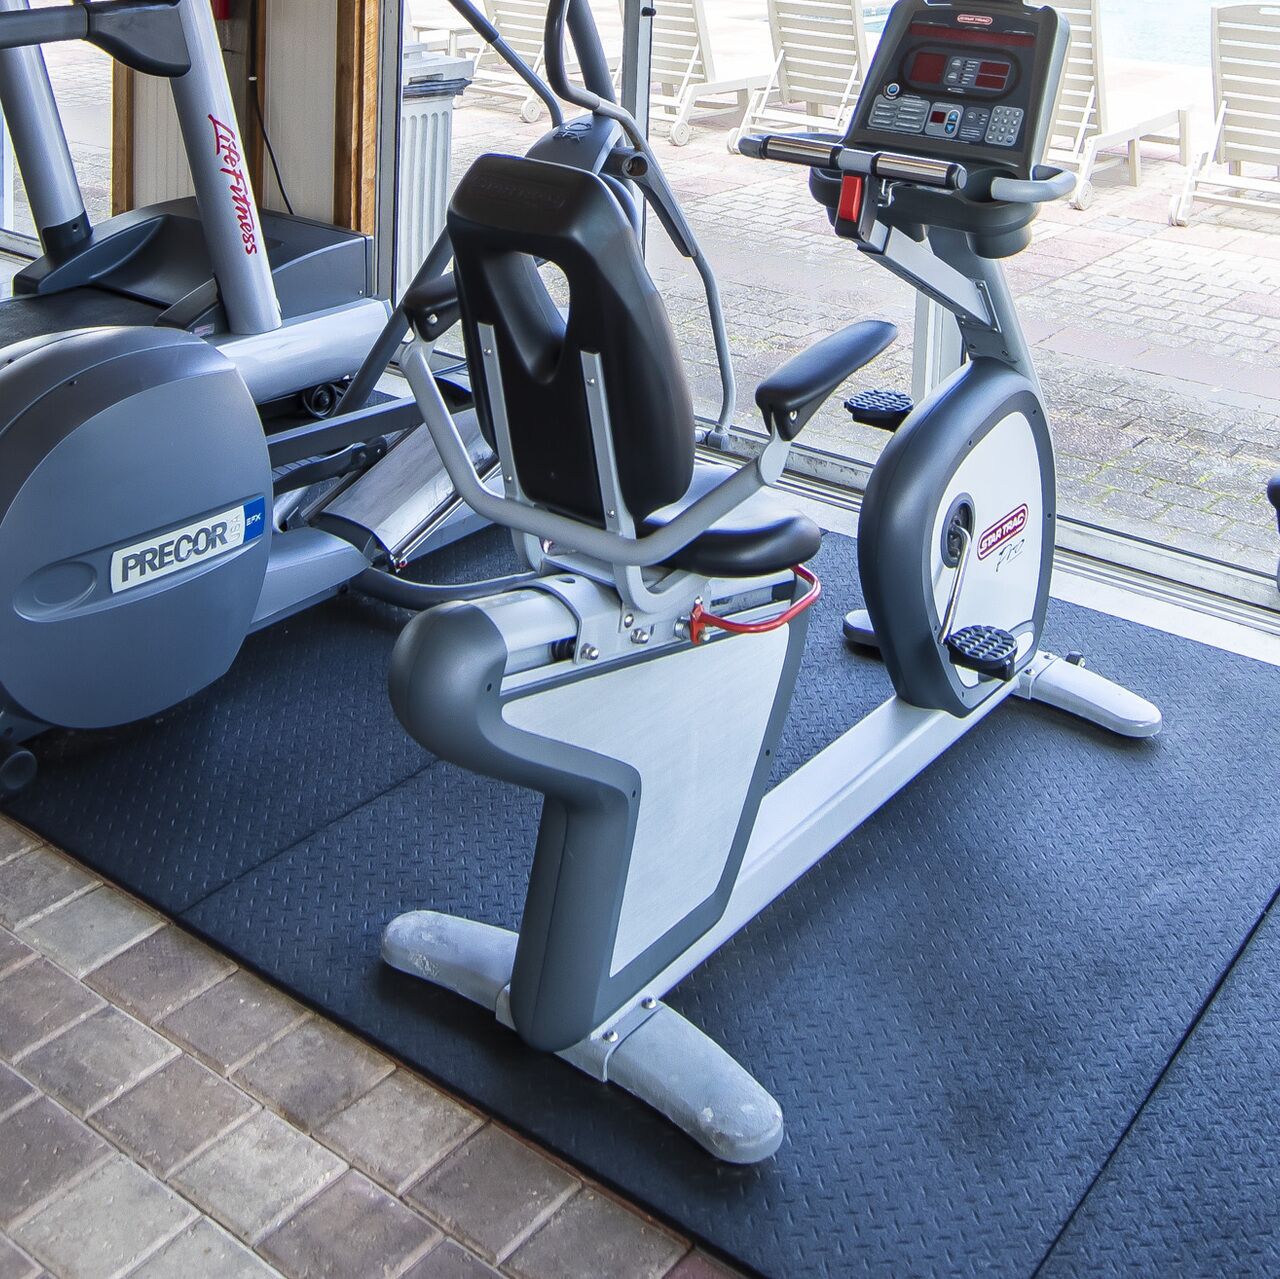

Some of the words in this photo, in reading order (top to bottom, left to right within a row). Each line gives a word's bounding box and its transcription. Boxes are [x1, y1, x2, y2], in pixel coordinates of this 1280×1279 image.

[121, 521, 229, 582] PRECOR
[229, 513, 241, 542] USA
[246, 512, 262, 526] EFX
[981, 526, 1003, 553] STAR
[1001, 511, 1024, 536] TRAC
